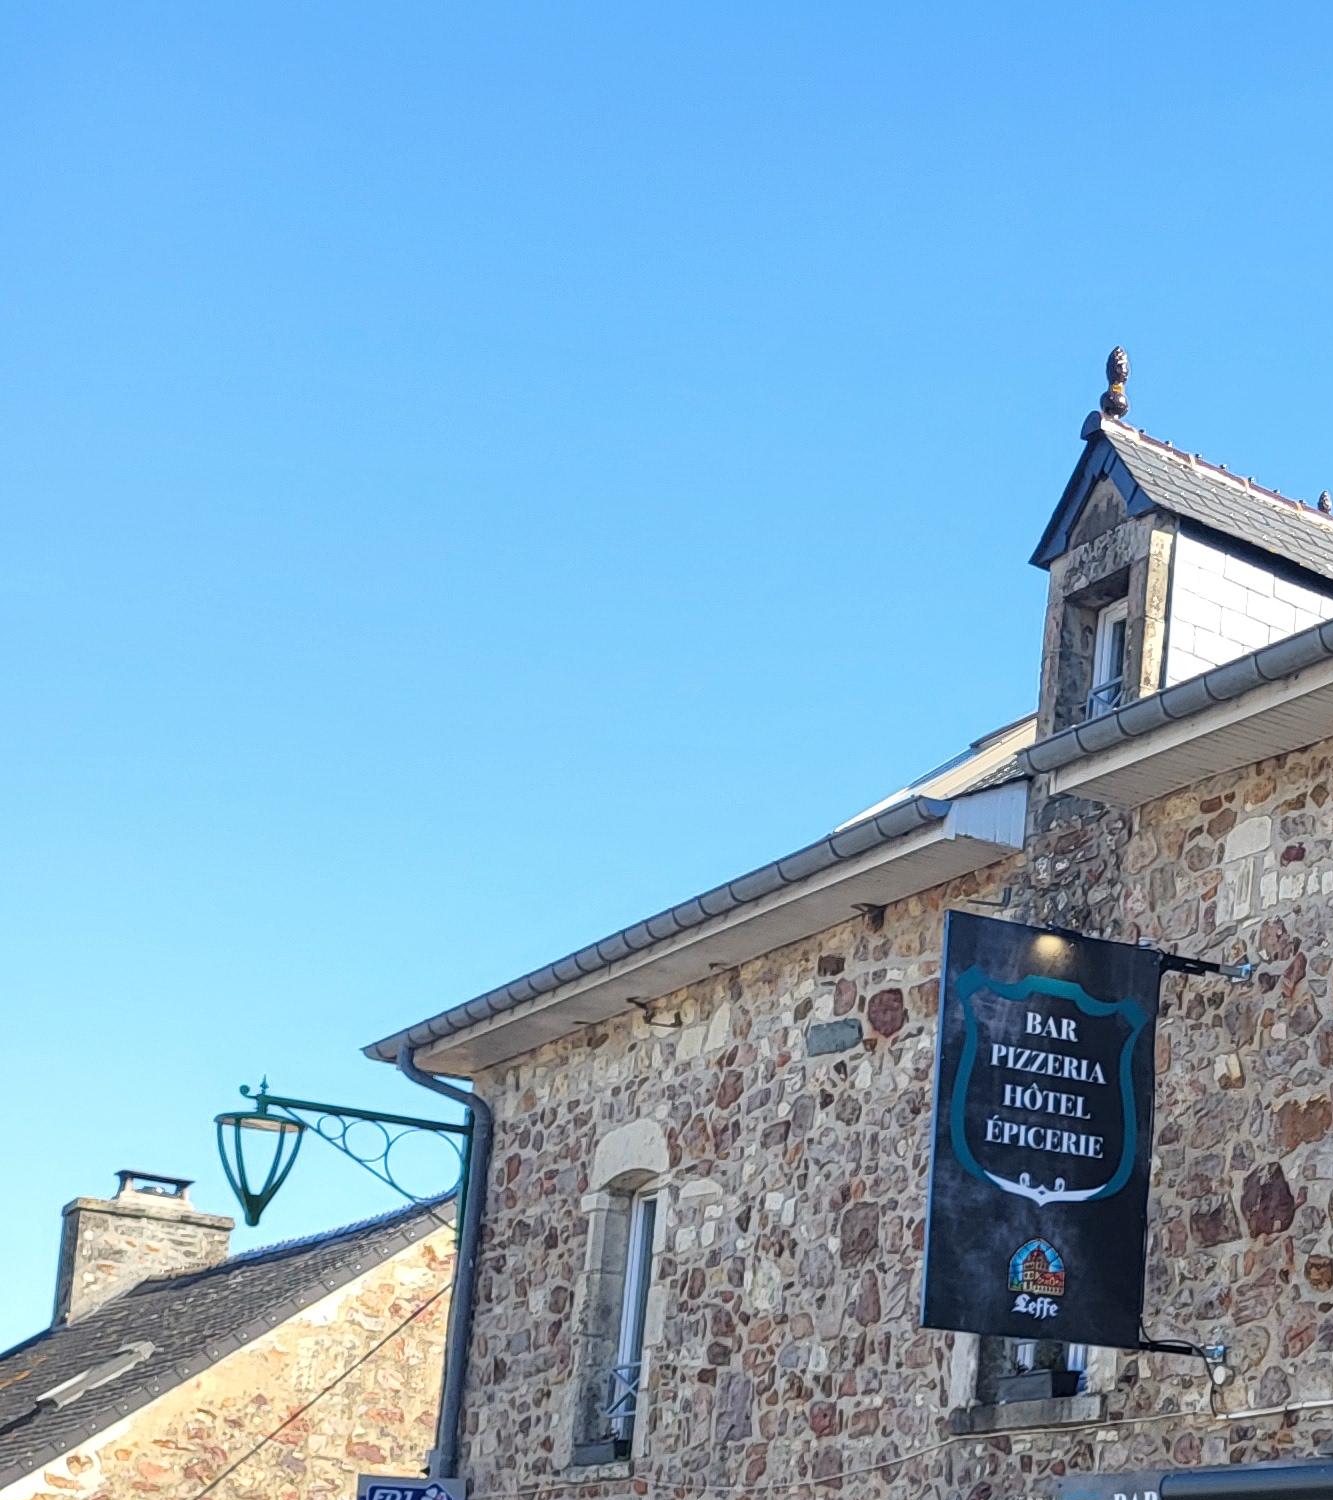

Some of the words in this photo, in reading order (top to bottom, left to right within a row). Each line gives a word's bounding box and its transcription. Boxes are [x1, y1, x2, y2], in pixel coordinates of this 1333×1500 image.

[1025, 1011, 1079, 1043] BAR
[990, 1043, 1108, 1086] PIZZERIA
[1001, 1081, 1092, 1121] HÔTEL
[984, 1114, 1105, 1160] ÉPICERIE
[1011, 1294, 1059, 1320] Leffe
